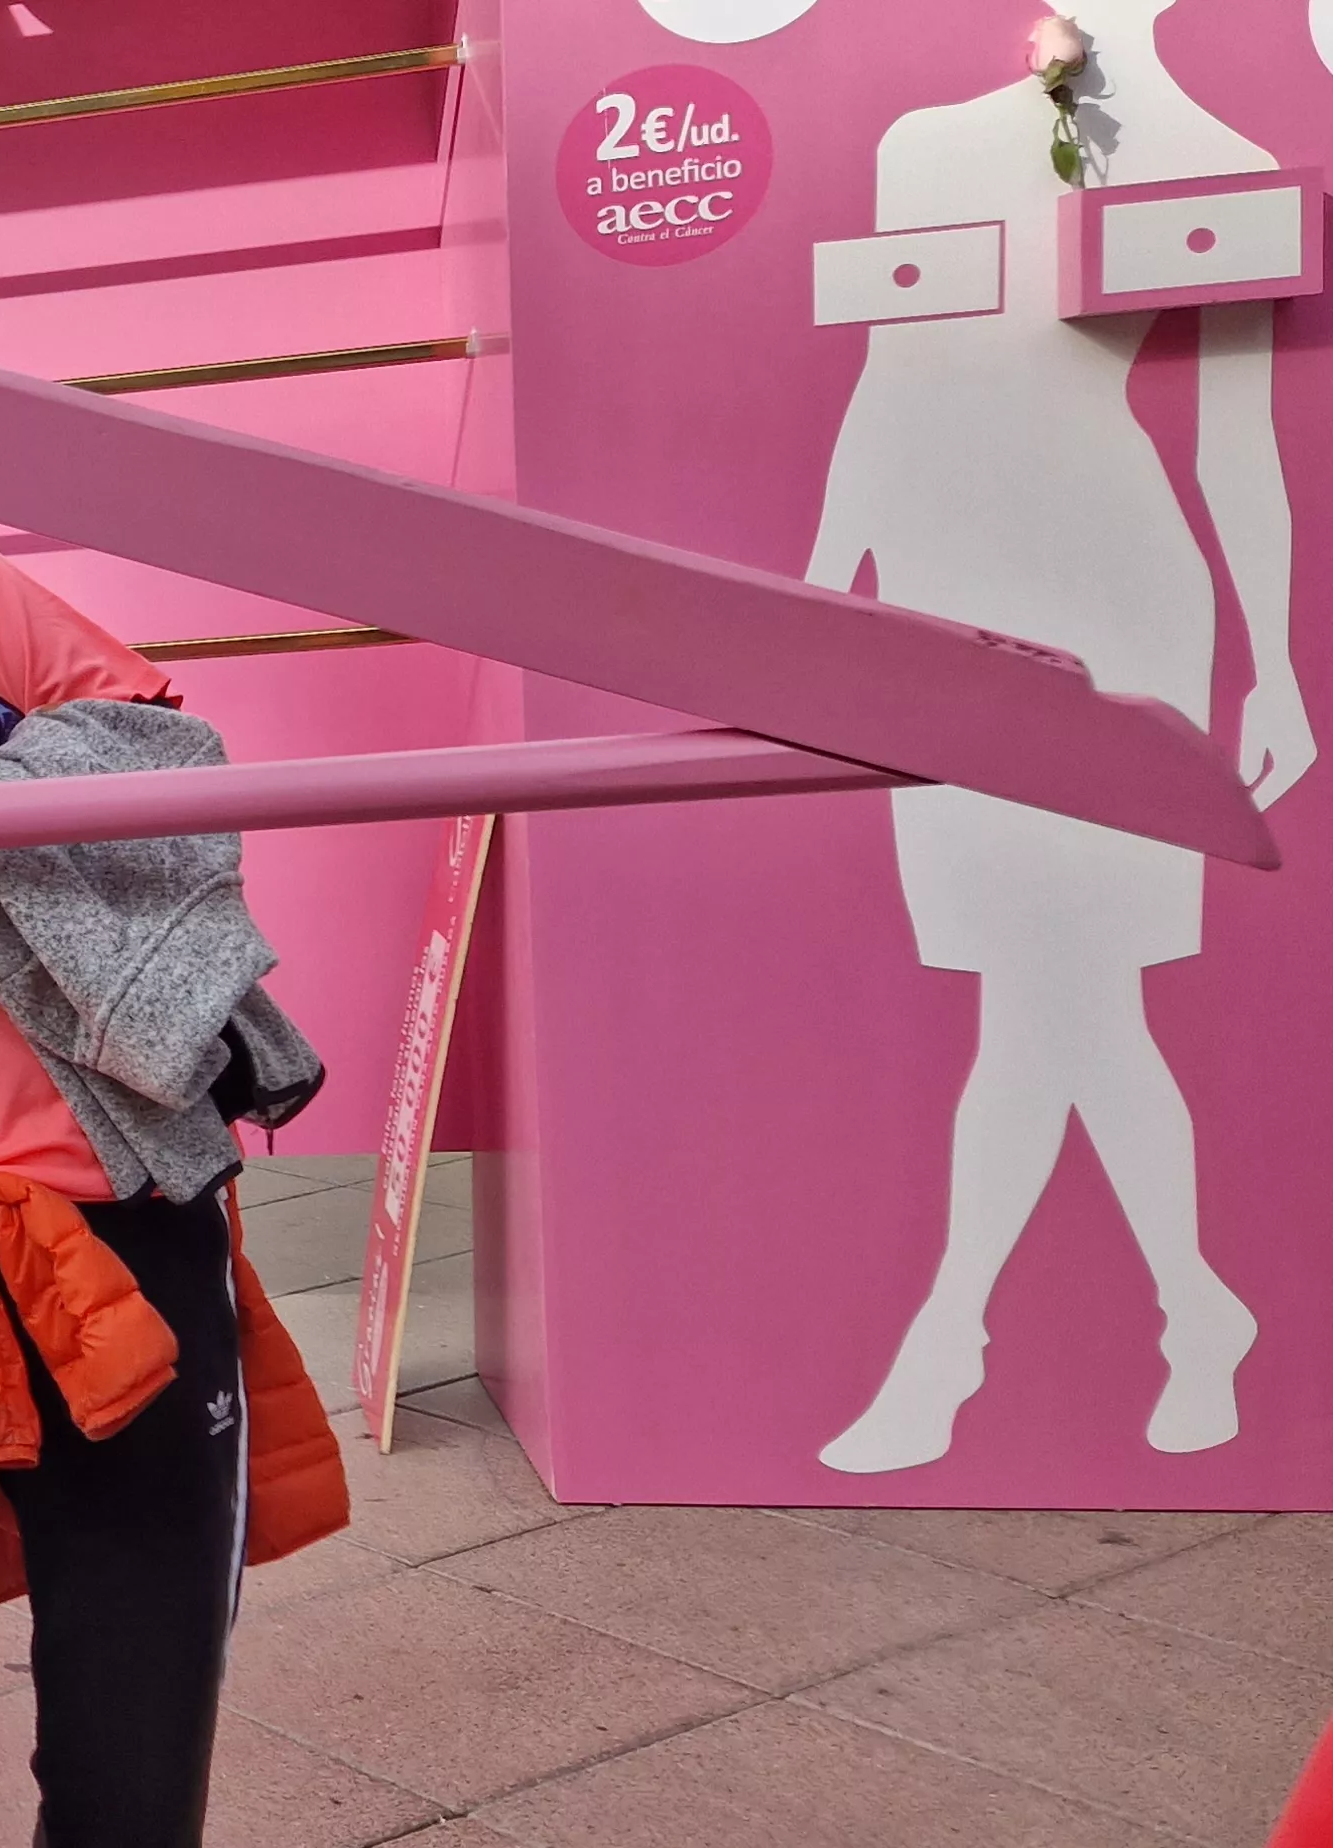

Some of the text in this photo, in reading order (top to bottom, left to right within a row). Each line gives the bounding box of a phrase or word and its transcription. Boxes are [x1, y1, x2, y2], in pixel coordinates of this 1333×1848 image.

[586, 155, 742, 196] a beneficio
[597, 191, 733, 235] aecc
[660, 228, 670, 240] el
